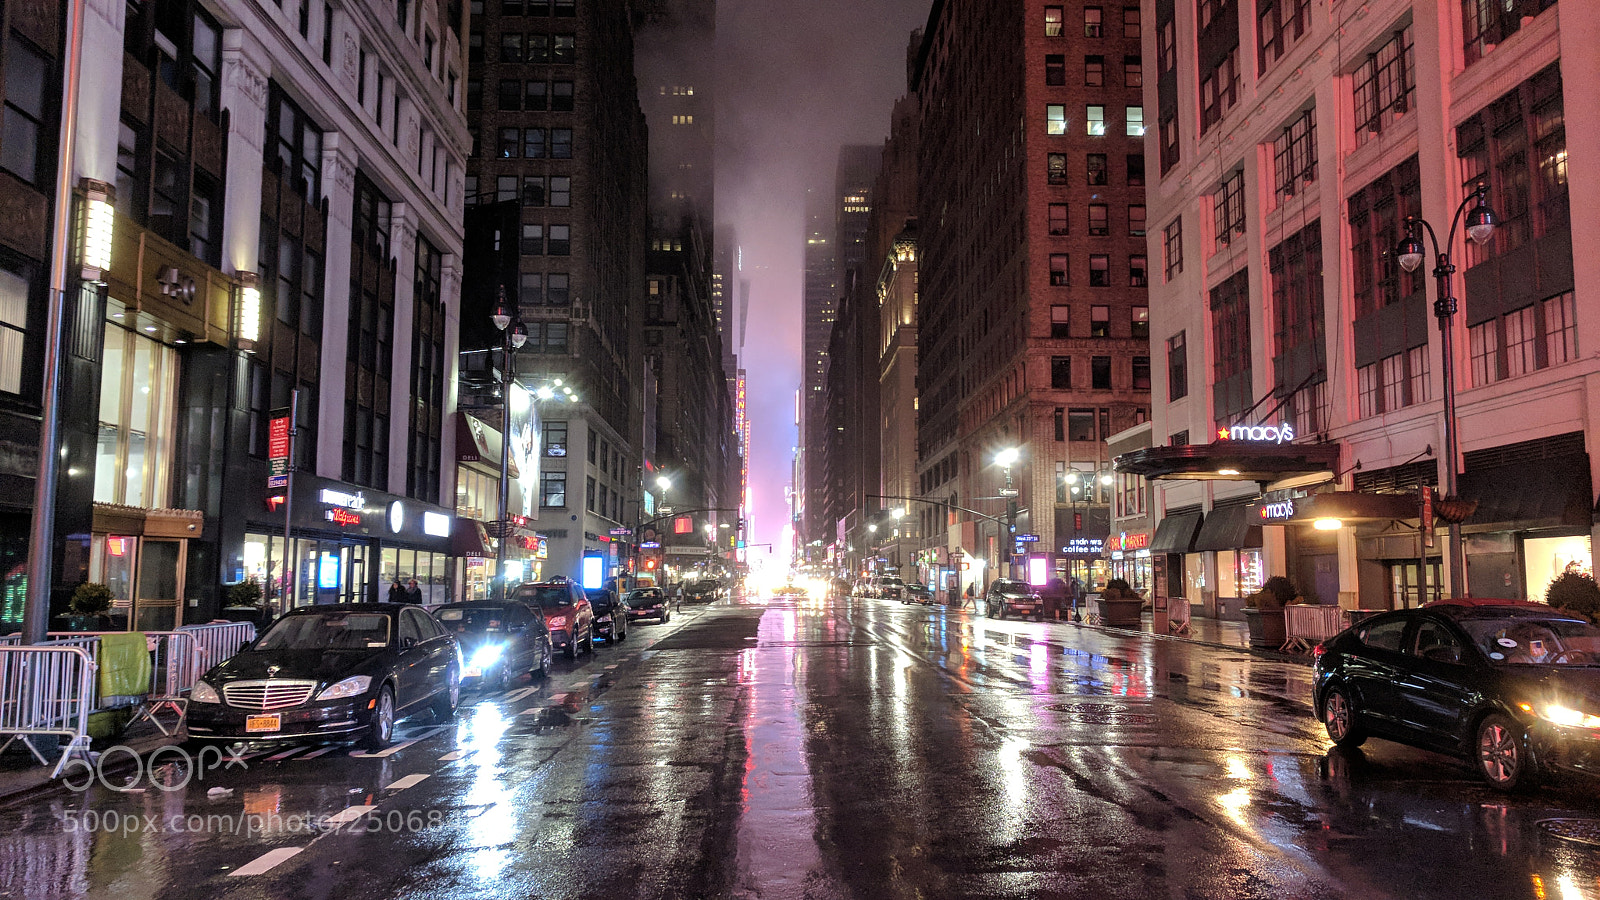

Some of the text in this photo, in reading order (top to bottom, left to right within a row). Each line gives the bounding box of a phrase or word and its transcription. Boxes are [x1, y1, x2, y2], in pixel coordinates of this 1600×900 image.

[1230, 422, 1294, 445] macy's
[1266, 499, 1294, 520] macy's
[1126, 533, 1148, 550] MARKET
